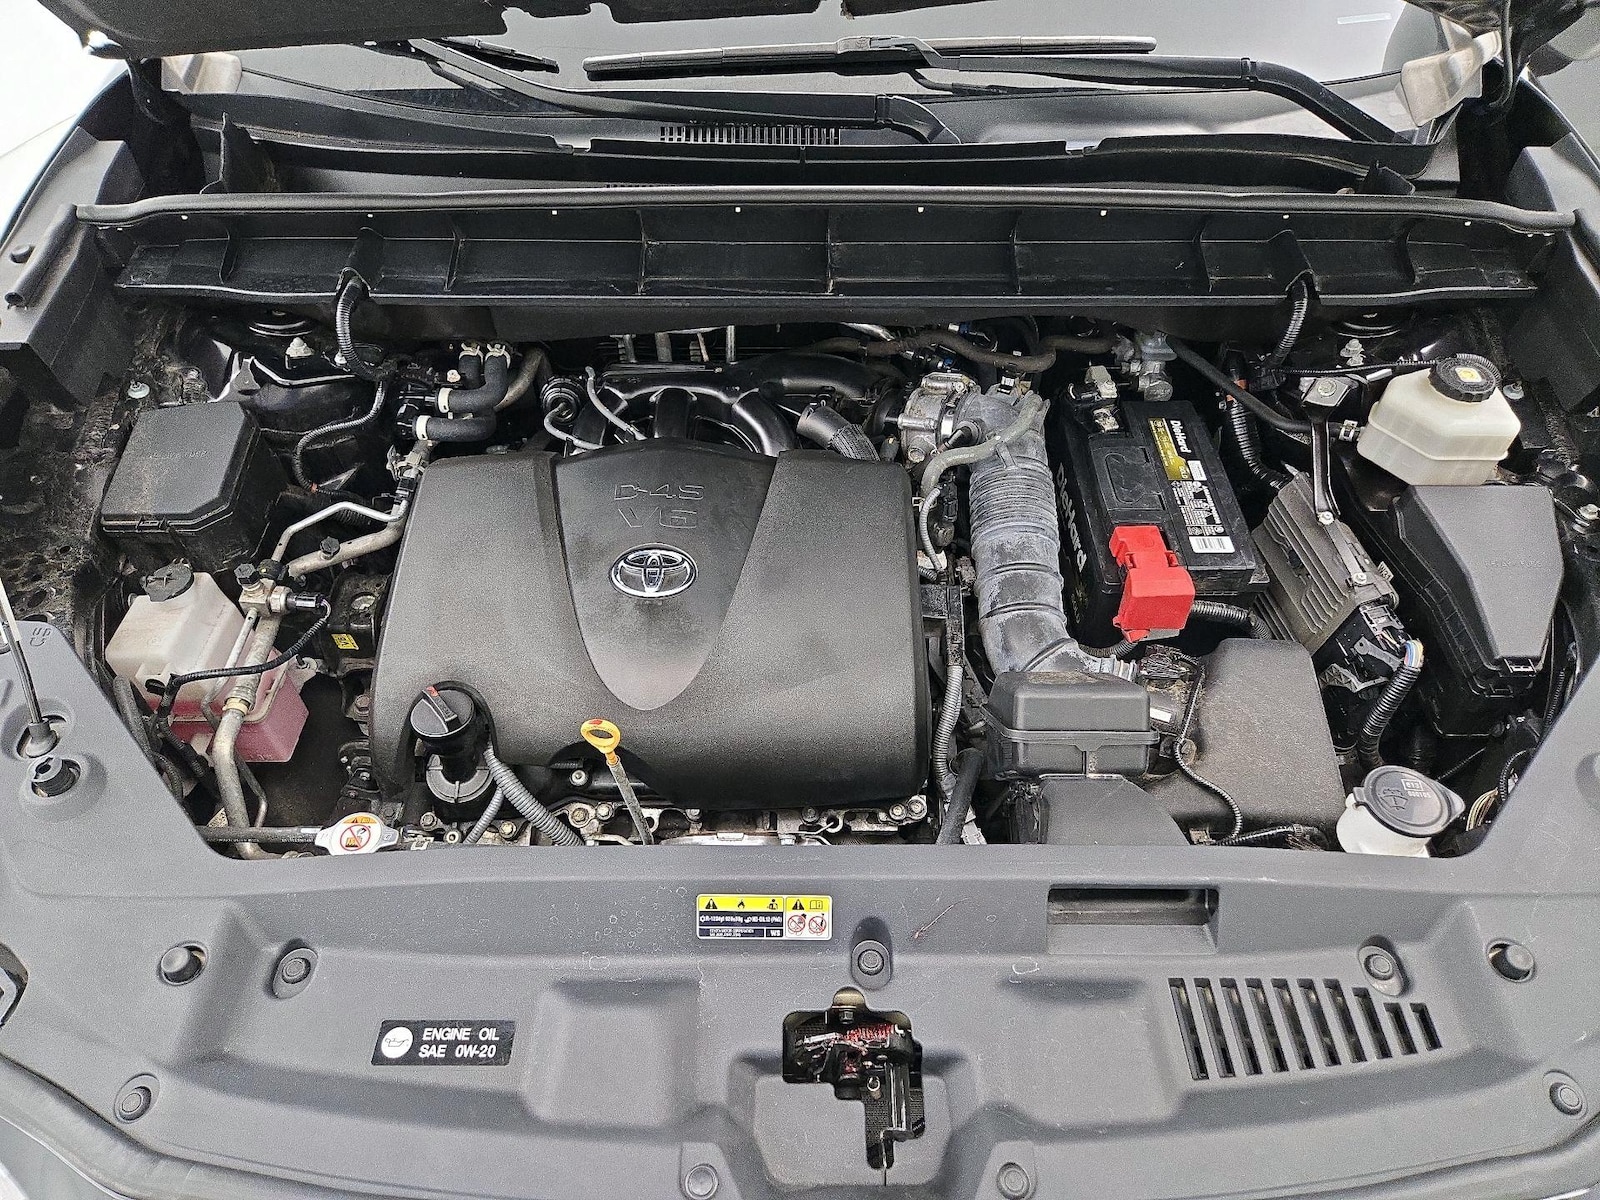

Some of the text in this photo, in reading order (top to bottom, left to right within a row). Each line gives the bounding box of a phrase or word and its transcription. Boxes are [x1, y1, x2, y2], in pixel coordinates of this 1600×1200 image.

[1170, 420, 1192, 453] DieHard
[1179, 466, 1189, 479] GOLD
[614, 483, 704, 501] D-4S
[618, 506, 698, 529] V6
[1057, 462, 1087, 573] DieHard
[422, 1027, 500, 1041] ENGINE OIL
[418, 1044, 497, 1058] SAE 0W-20
